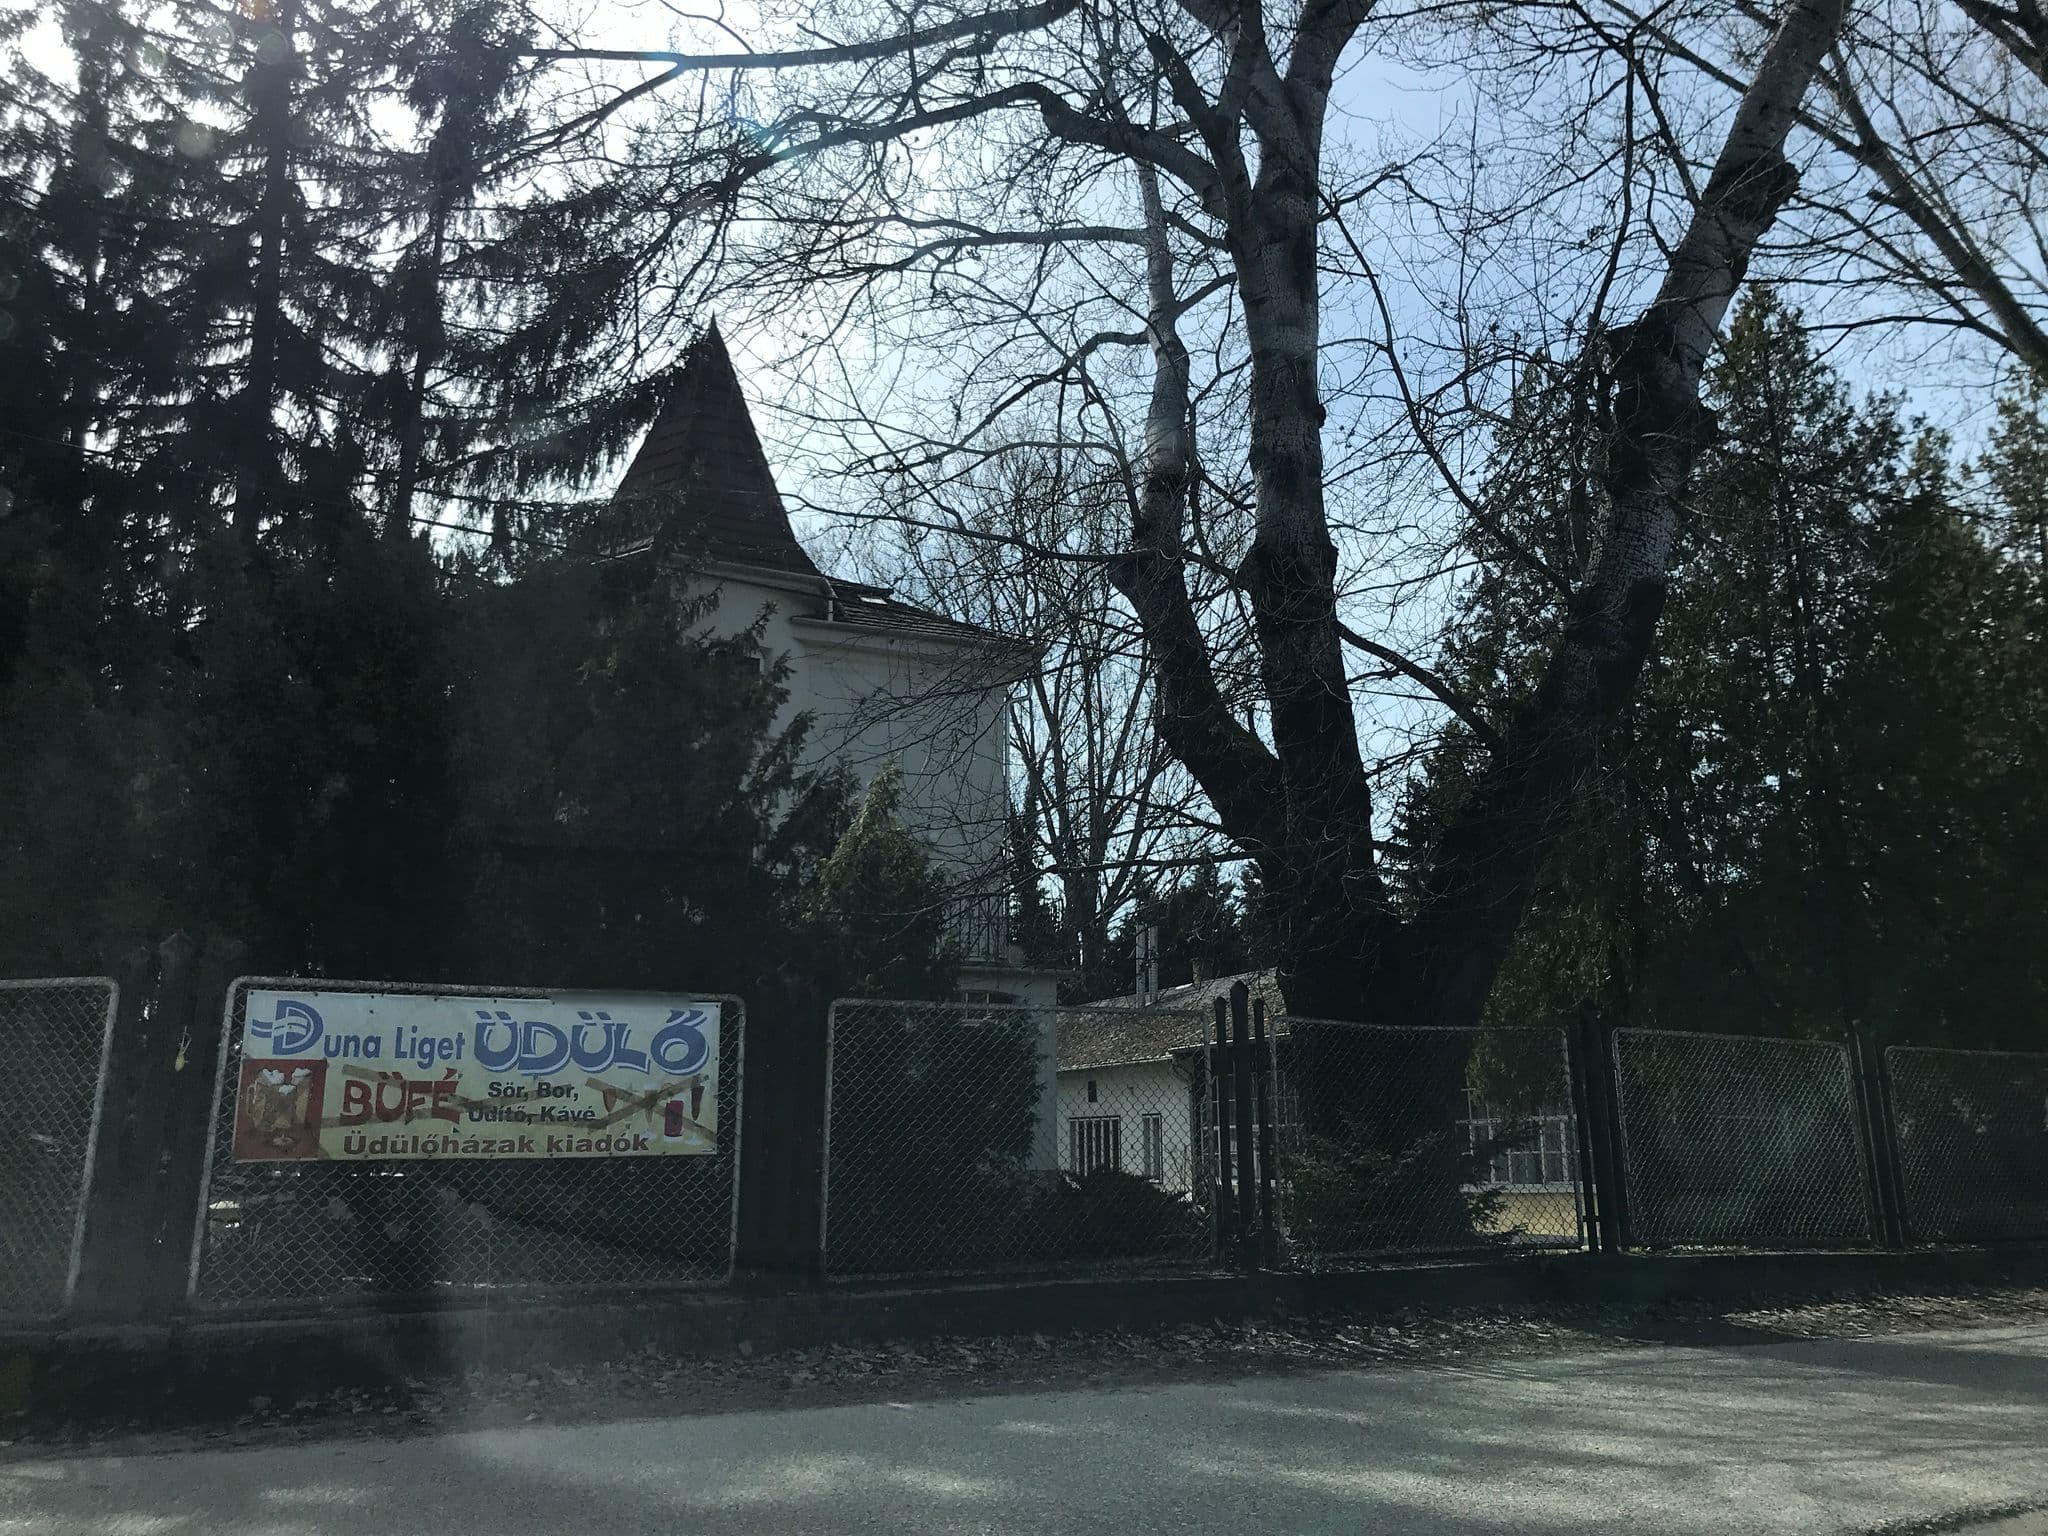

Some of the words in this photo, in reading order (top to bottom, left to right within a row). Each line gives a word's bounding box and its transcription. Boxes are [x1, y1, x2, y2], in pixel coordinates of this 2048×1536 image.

[268, 1000, 382, 1059] Duna
[394, 1025, 466, 1070] Liget
[473, 1009, 710, 1076] ÜDÜLŐ
[340, 1067, 460, 1126] BÜFÉ
[487, 1081, 529, 1101] Sör,
[537, 1081, 579, 1101] Bor,
[539, 1105, 597, 1124] Kávé
[343, 1129, 536, 1155] Üdülőházak
[546, 1132, 649, 1154] kiadók
